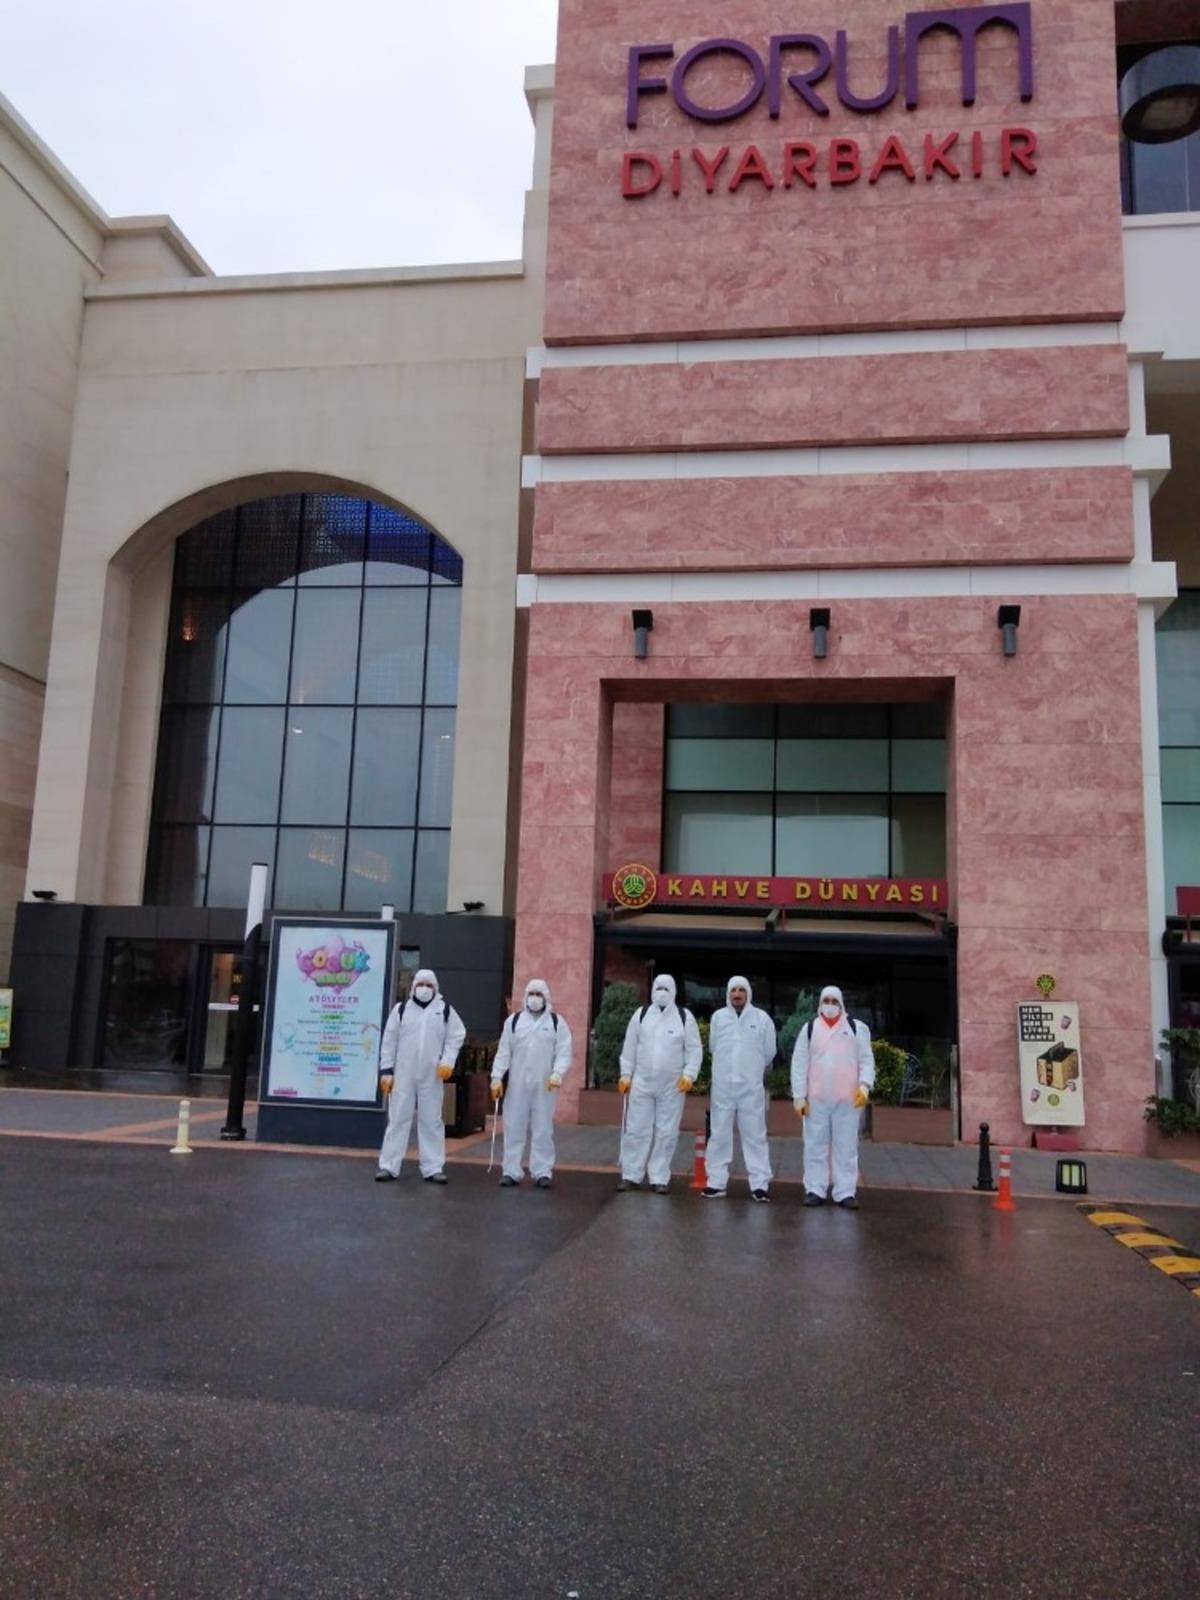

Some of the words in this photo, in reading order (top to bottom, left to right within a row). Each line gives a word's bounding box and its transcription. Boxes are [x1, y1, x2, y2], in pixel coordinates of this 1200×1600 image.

[626, 2, 1033, 129] FORUM
[622, 127, 1037, 198] DİYARBAKIR
[667, 879, 769, 898] KAHVE
[795, 878, 939, 902] DÜNYASI
